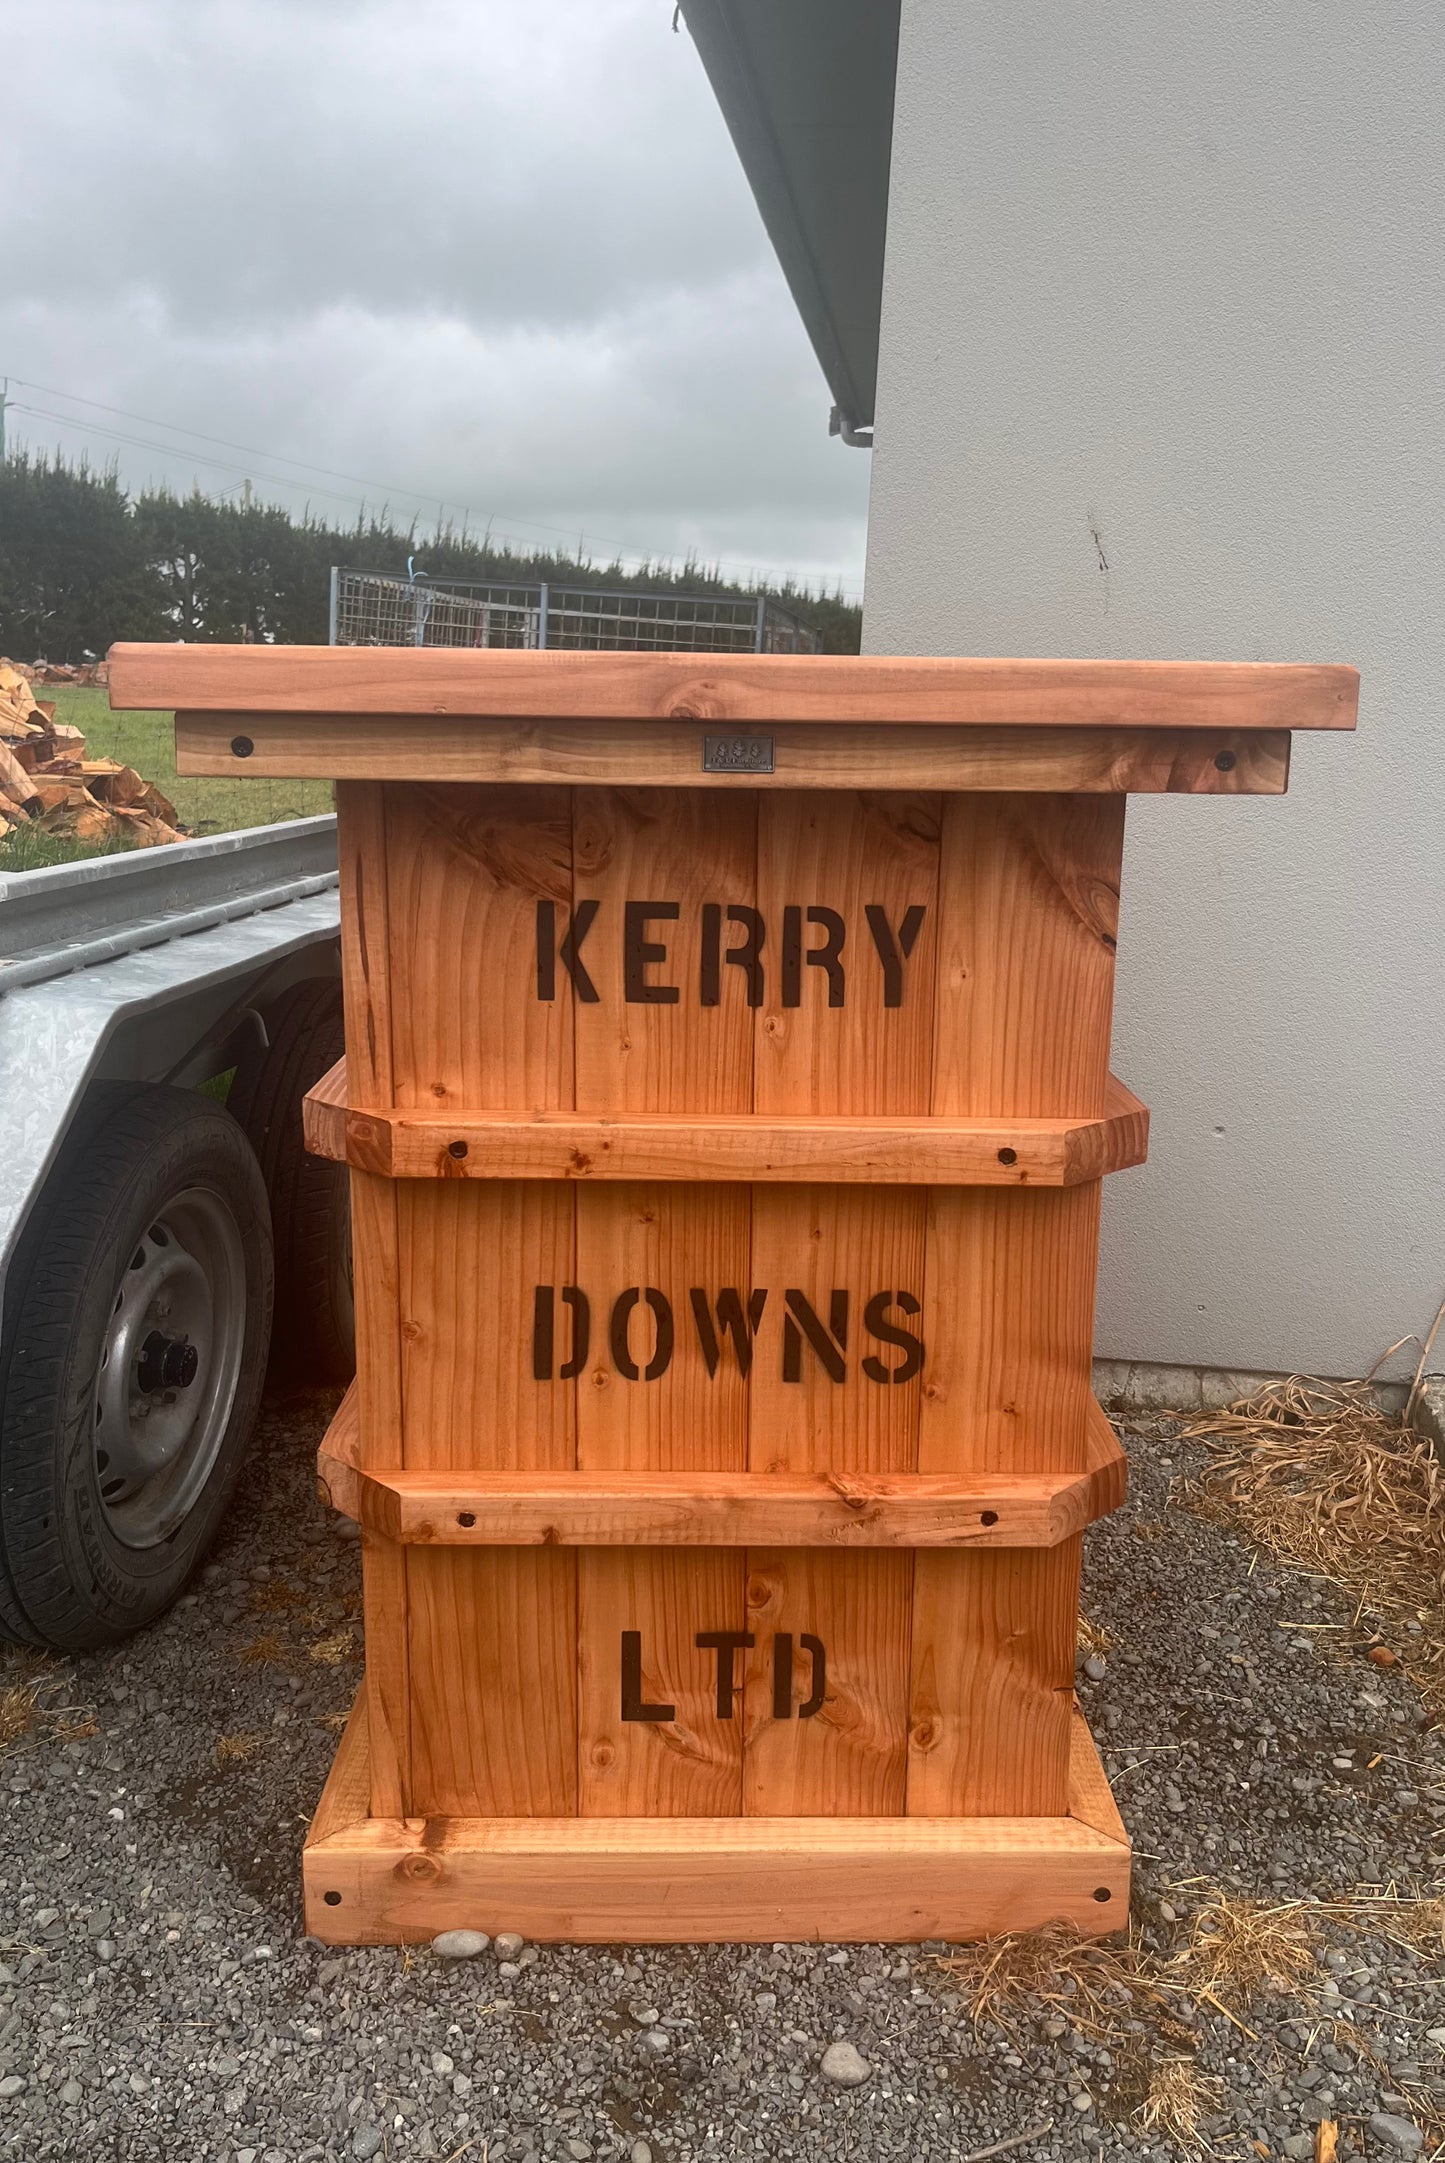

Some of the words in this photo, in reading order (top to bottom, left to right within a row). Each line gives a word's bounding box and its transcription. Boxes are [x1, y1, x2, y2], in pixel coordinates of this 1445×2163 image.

[536, 899, 927, 1008] KERRY
[533, 1285, 926, 1384] DOWNS
[621, 1630, 826, 1722] LTD
